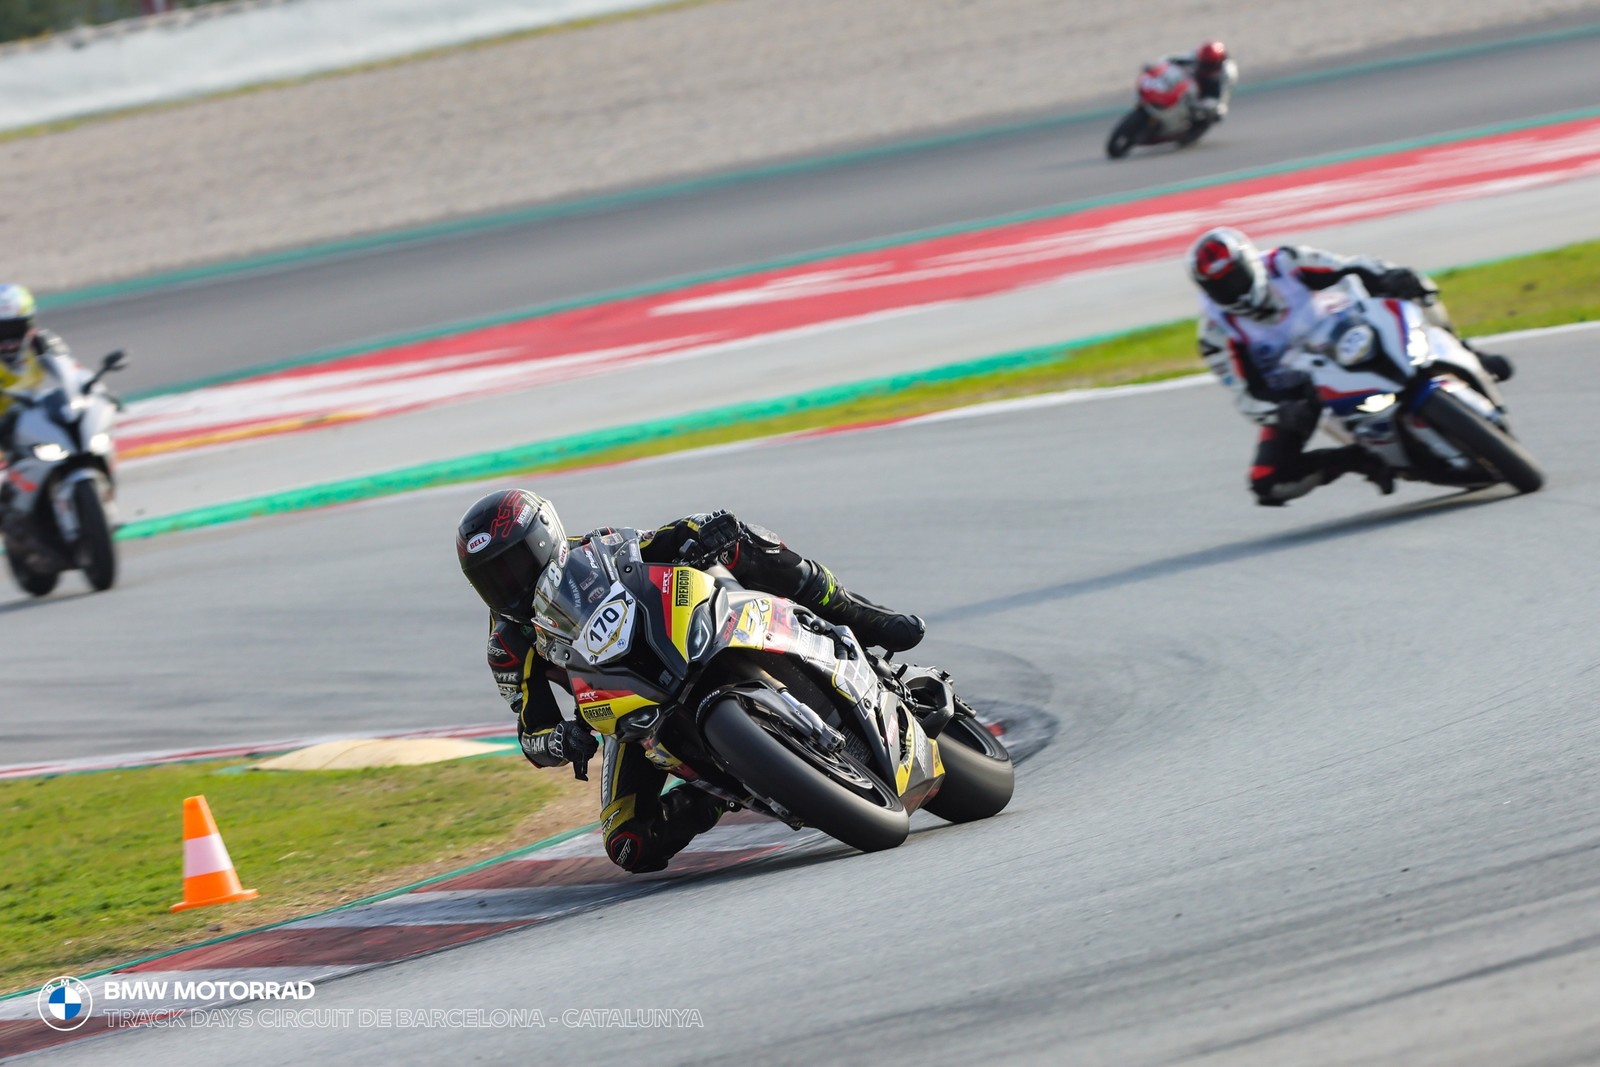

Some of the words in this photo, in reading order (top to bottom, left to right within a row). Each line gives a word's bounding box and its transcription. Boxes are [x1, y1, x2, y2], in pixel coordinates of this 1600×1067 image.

[470, 537, 487, 550] BELL
[568, 579, 581, 608] YAMAHA
[590, 607, 620, 643] 170
